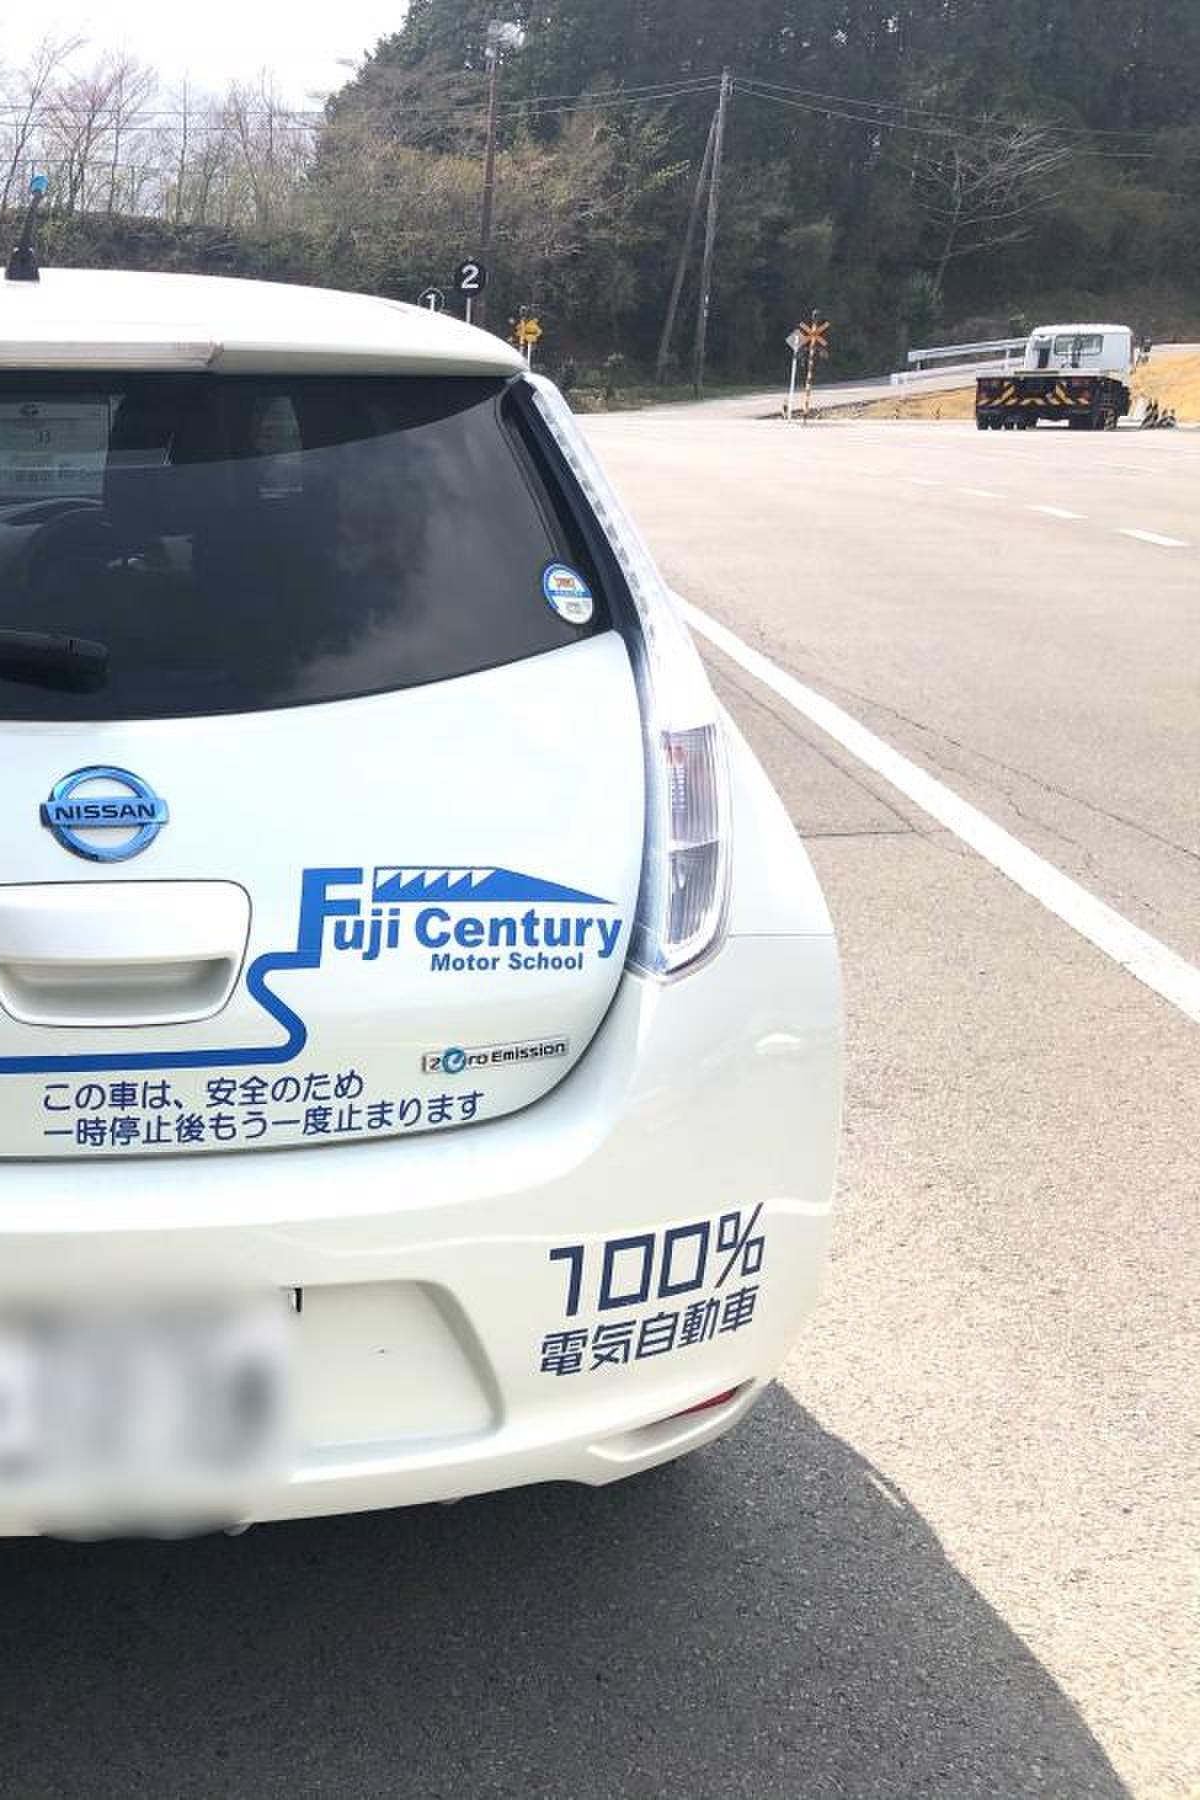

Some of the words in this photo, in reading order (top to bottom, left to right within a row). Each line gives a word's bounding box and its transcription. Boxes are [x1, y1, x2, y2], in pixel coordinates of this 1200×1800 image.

[461, 264, 480, 289] 2
[426, 293, 435, 311] 1
[55, 803, 156, 820] NISSAN
[298, 868, 400, 967] Fuji
[415, 907, 622, 958] Century
[431, 953, 499, 971] Motor
[508, 952, 583, 971] School
[491, 1042, 566, 1063] Emission
[43, 1069, 364, 1111] この車は、安全のため
[43, 1090, 484, 1147] 一時停止後もう一度止まります
[549, 1202, 766, 1317] 100%
[540, 1285, 760, 1377] 電気自動車
